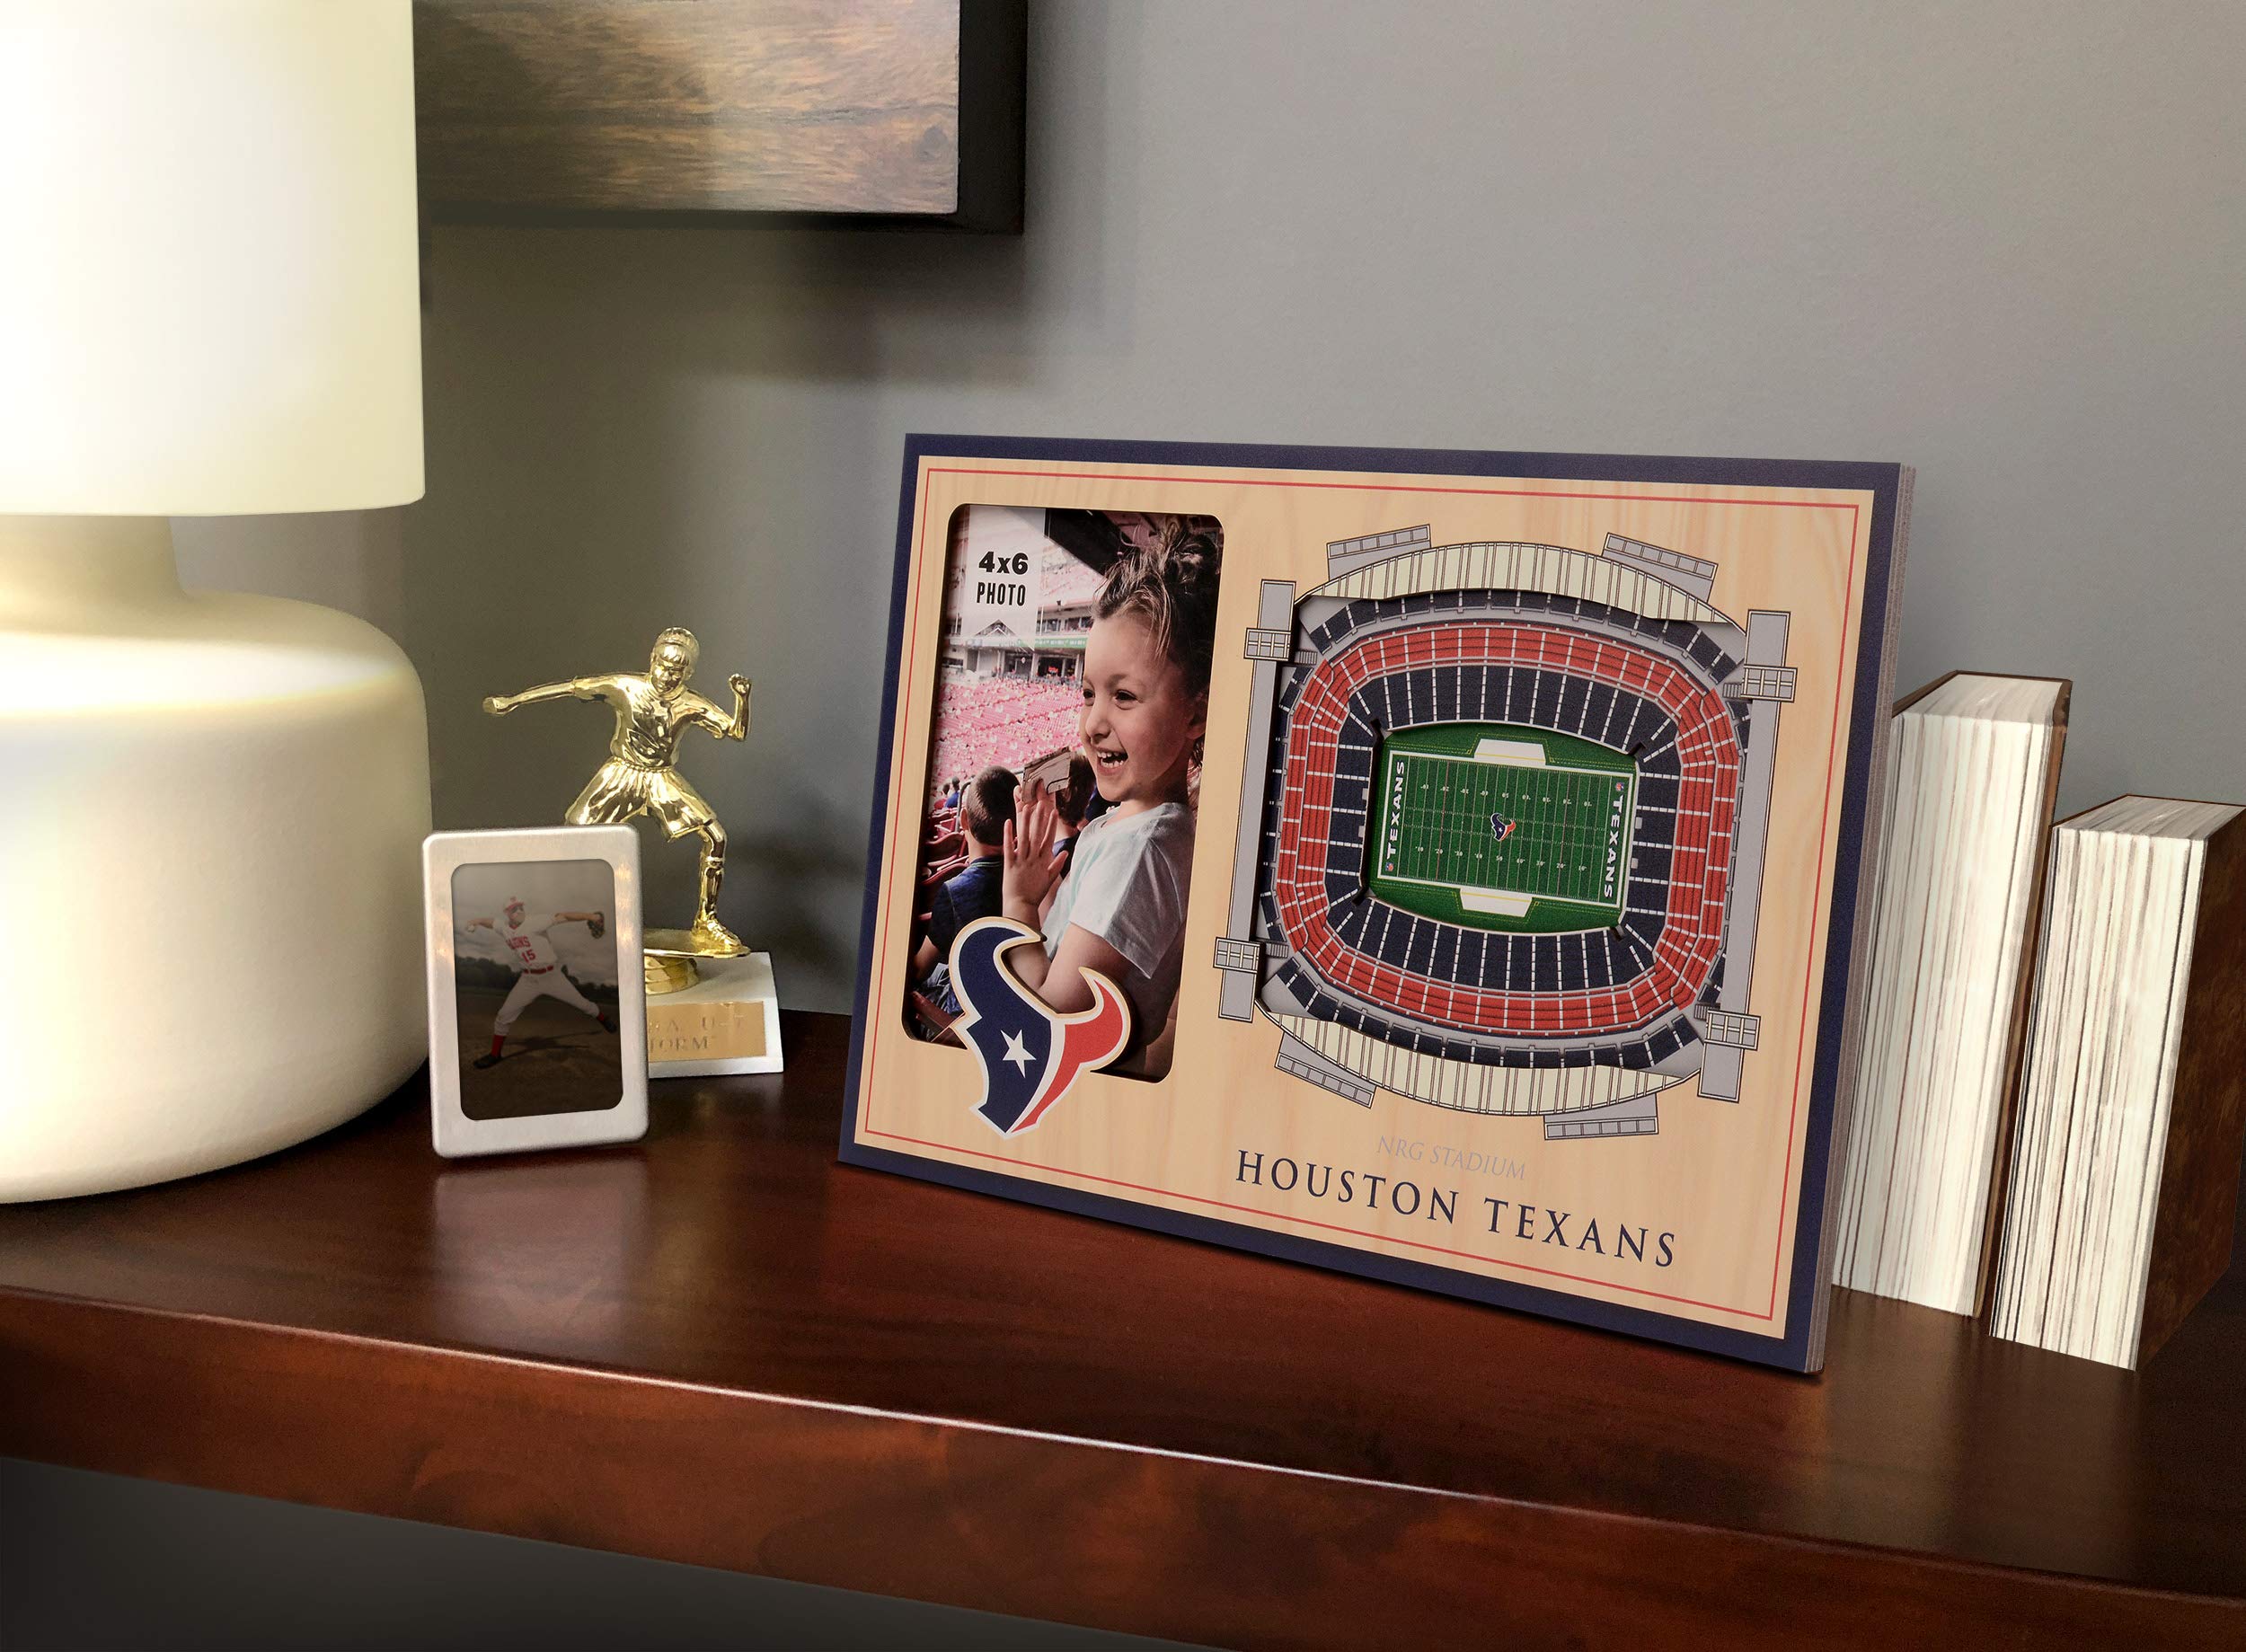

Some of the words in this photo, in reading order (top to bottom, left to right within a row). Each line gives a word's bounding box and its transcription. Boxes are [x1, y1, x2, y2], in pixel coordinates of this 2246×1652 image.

[978, 551, 1029, 576] 4x6
[976, 581, 1026, 606] PHOTO
[1386, 761, 1405, 860] TEXANS
[1604, 794, 1624, 898] TEXANS
[521, 949, 536, 966] 15
[1377, 1135, 1425, 1161] NRG
[1429, 1144, 1525, 1180] STADIUM
[1235, 1149, 1460, 1224] HOUSTON
[1483, 1197, 1676, 1268] TEXANS
